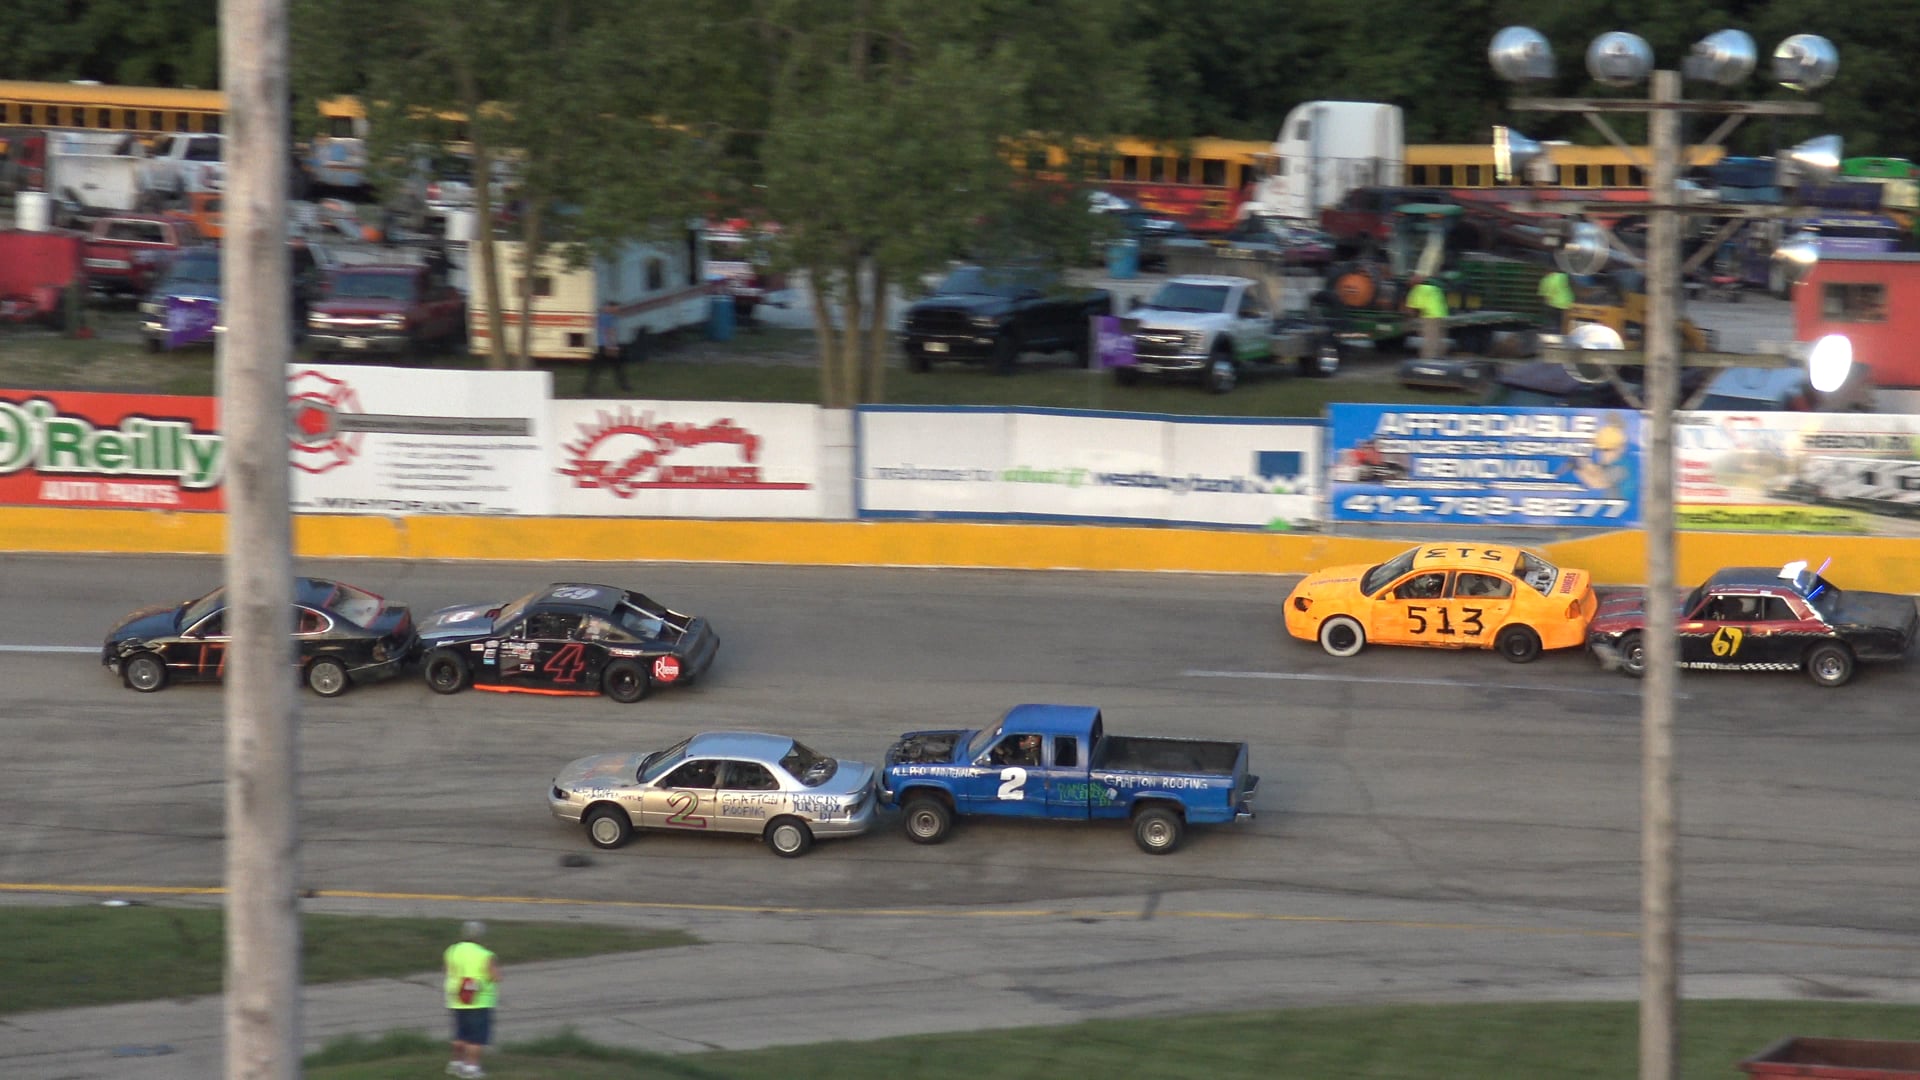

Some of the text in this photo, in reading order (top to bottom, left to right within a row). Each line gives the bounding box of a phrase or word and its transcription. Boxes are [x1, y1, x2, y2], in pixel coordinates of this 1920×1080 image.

[1375, 413, 1598, 438] AFFORDABLE
[1408, 606, 1484, 635] 513
[1711, 626, 1743, 656] 67
[543, 643, 585, 682] 4
[1690, 662, 1717, 670] AUTO
[997, 767, 1027, 800] 2
[1162, 777, 1208, 790] ROOFING
[665, 791, 707, 828] 2
